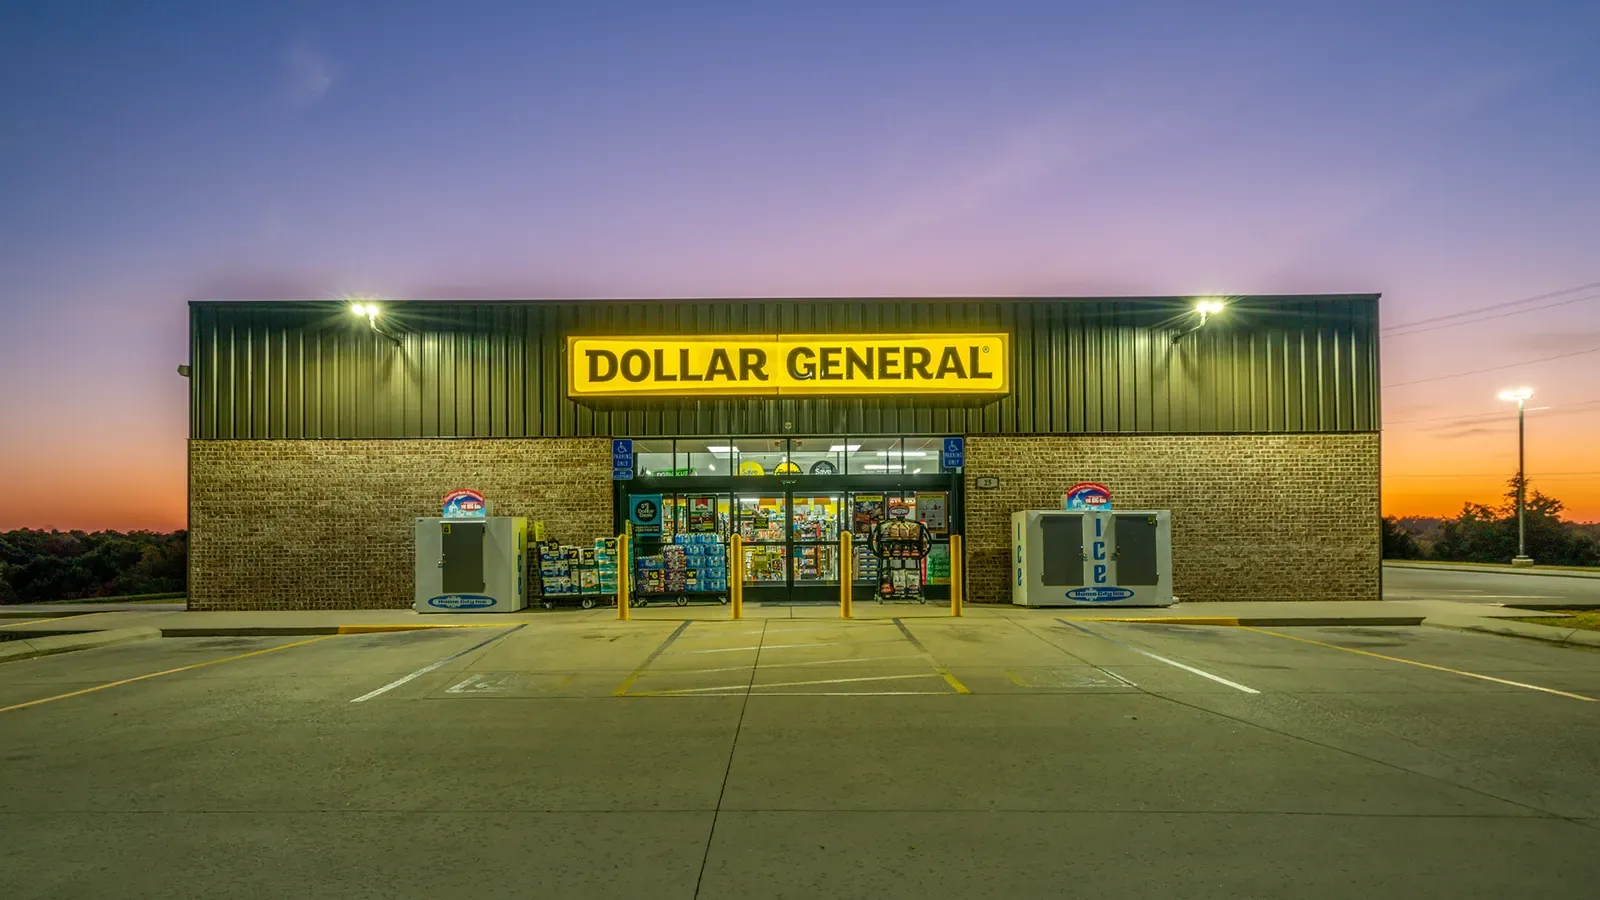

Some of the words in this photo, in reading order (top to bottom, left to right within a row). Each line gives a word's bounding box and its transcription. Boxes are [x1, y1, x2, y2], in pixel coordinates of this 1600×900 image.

[585, 348, 769, 382] DOLLAR
[786, 346, 993, 381] GENERAL
[815, 467, 832, 475] Save
